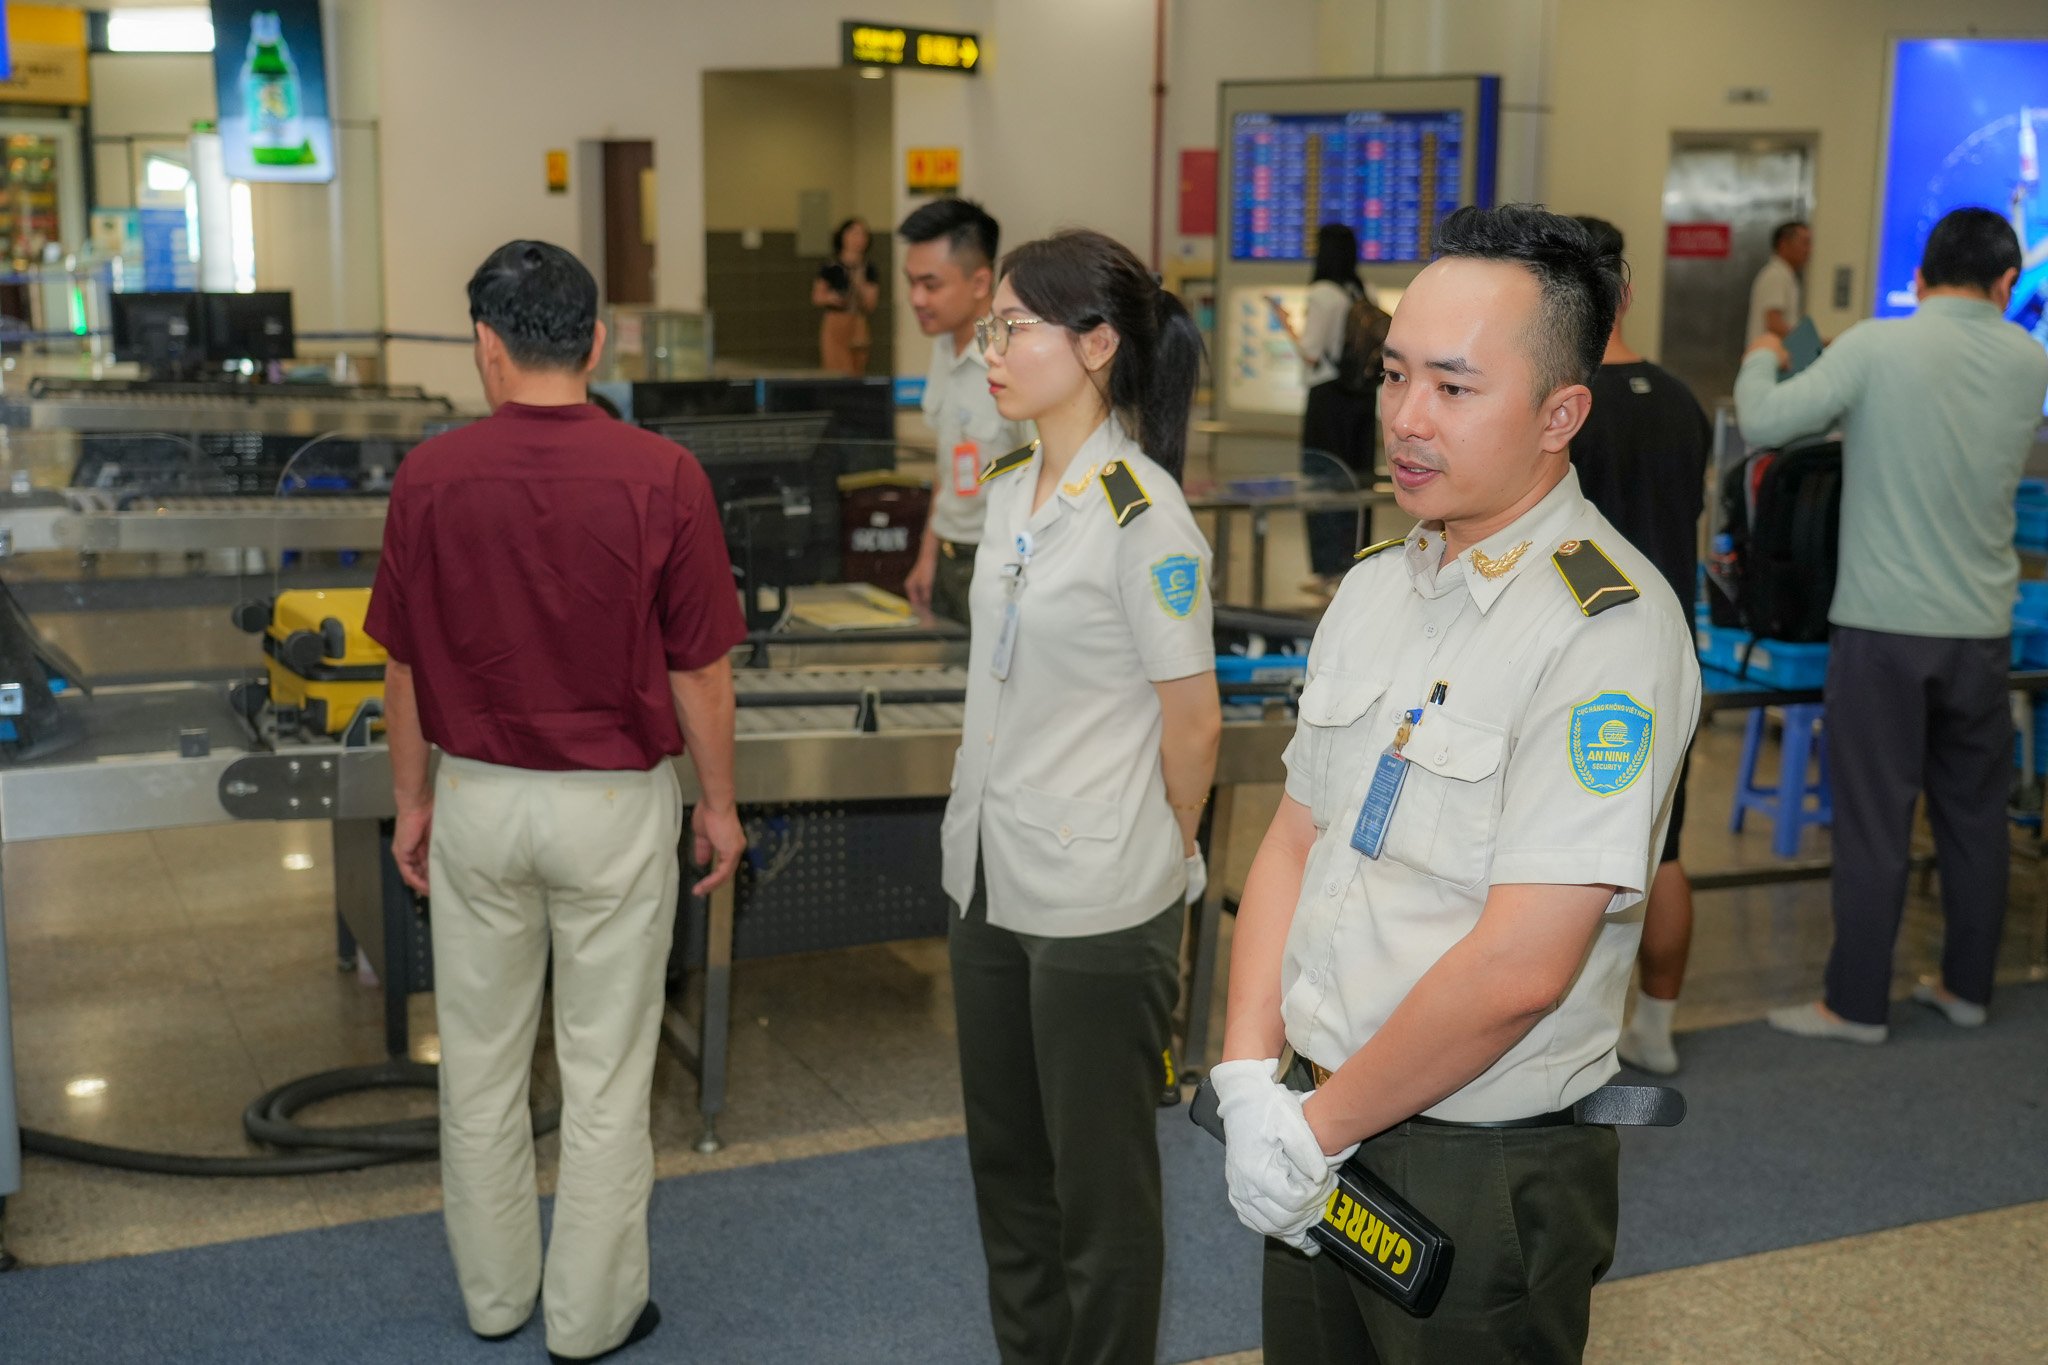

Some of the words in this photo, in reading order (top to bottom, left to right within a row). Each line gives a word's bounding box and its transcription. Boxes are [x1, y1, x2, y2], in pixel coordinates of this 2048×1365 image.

[1587, 750, 1603, 761] AN
[1605, 751, 1630, 763] NINH
[1592, 763, 1622, 771] SECURITY
